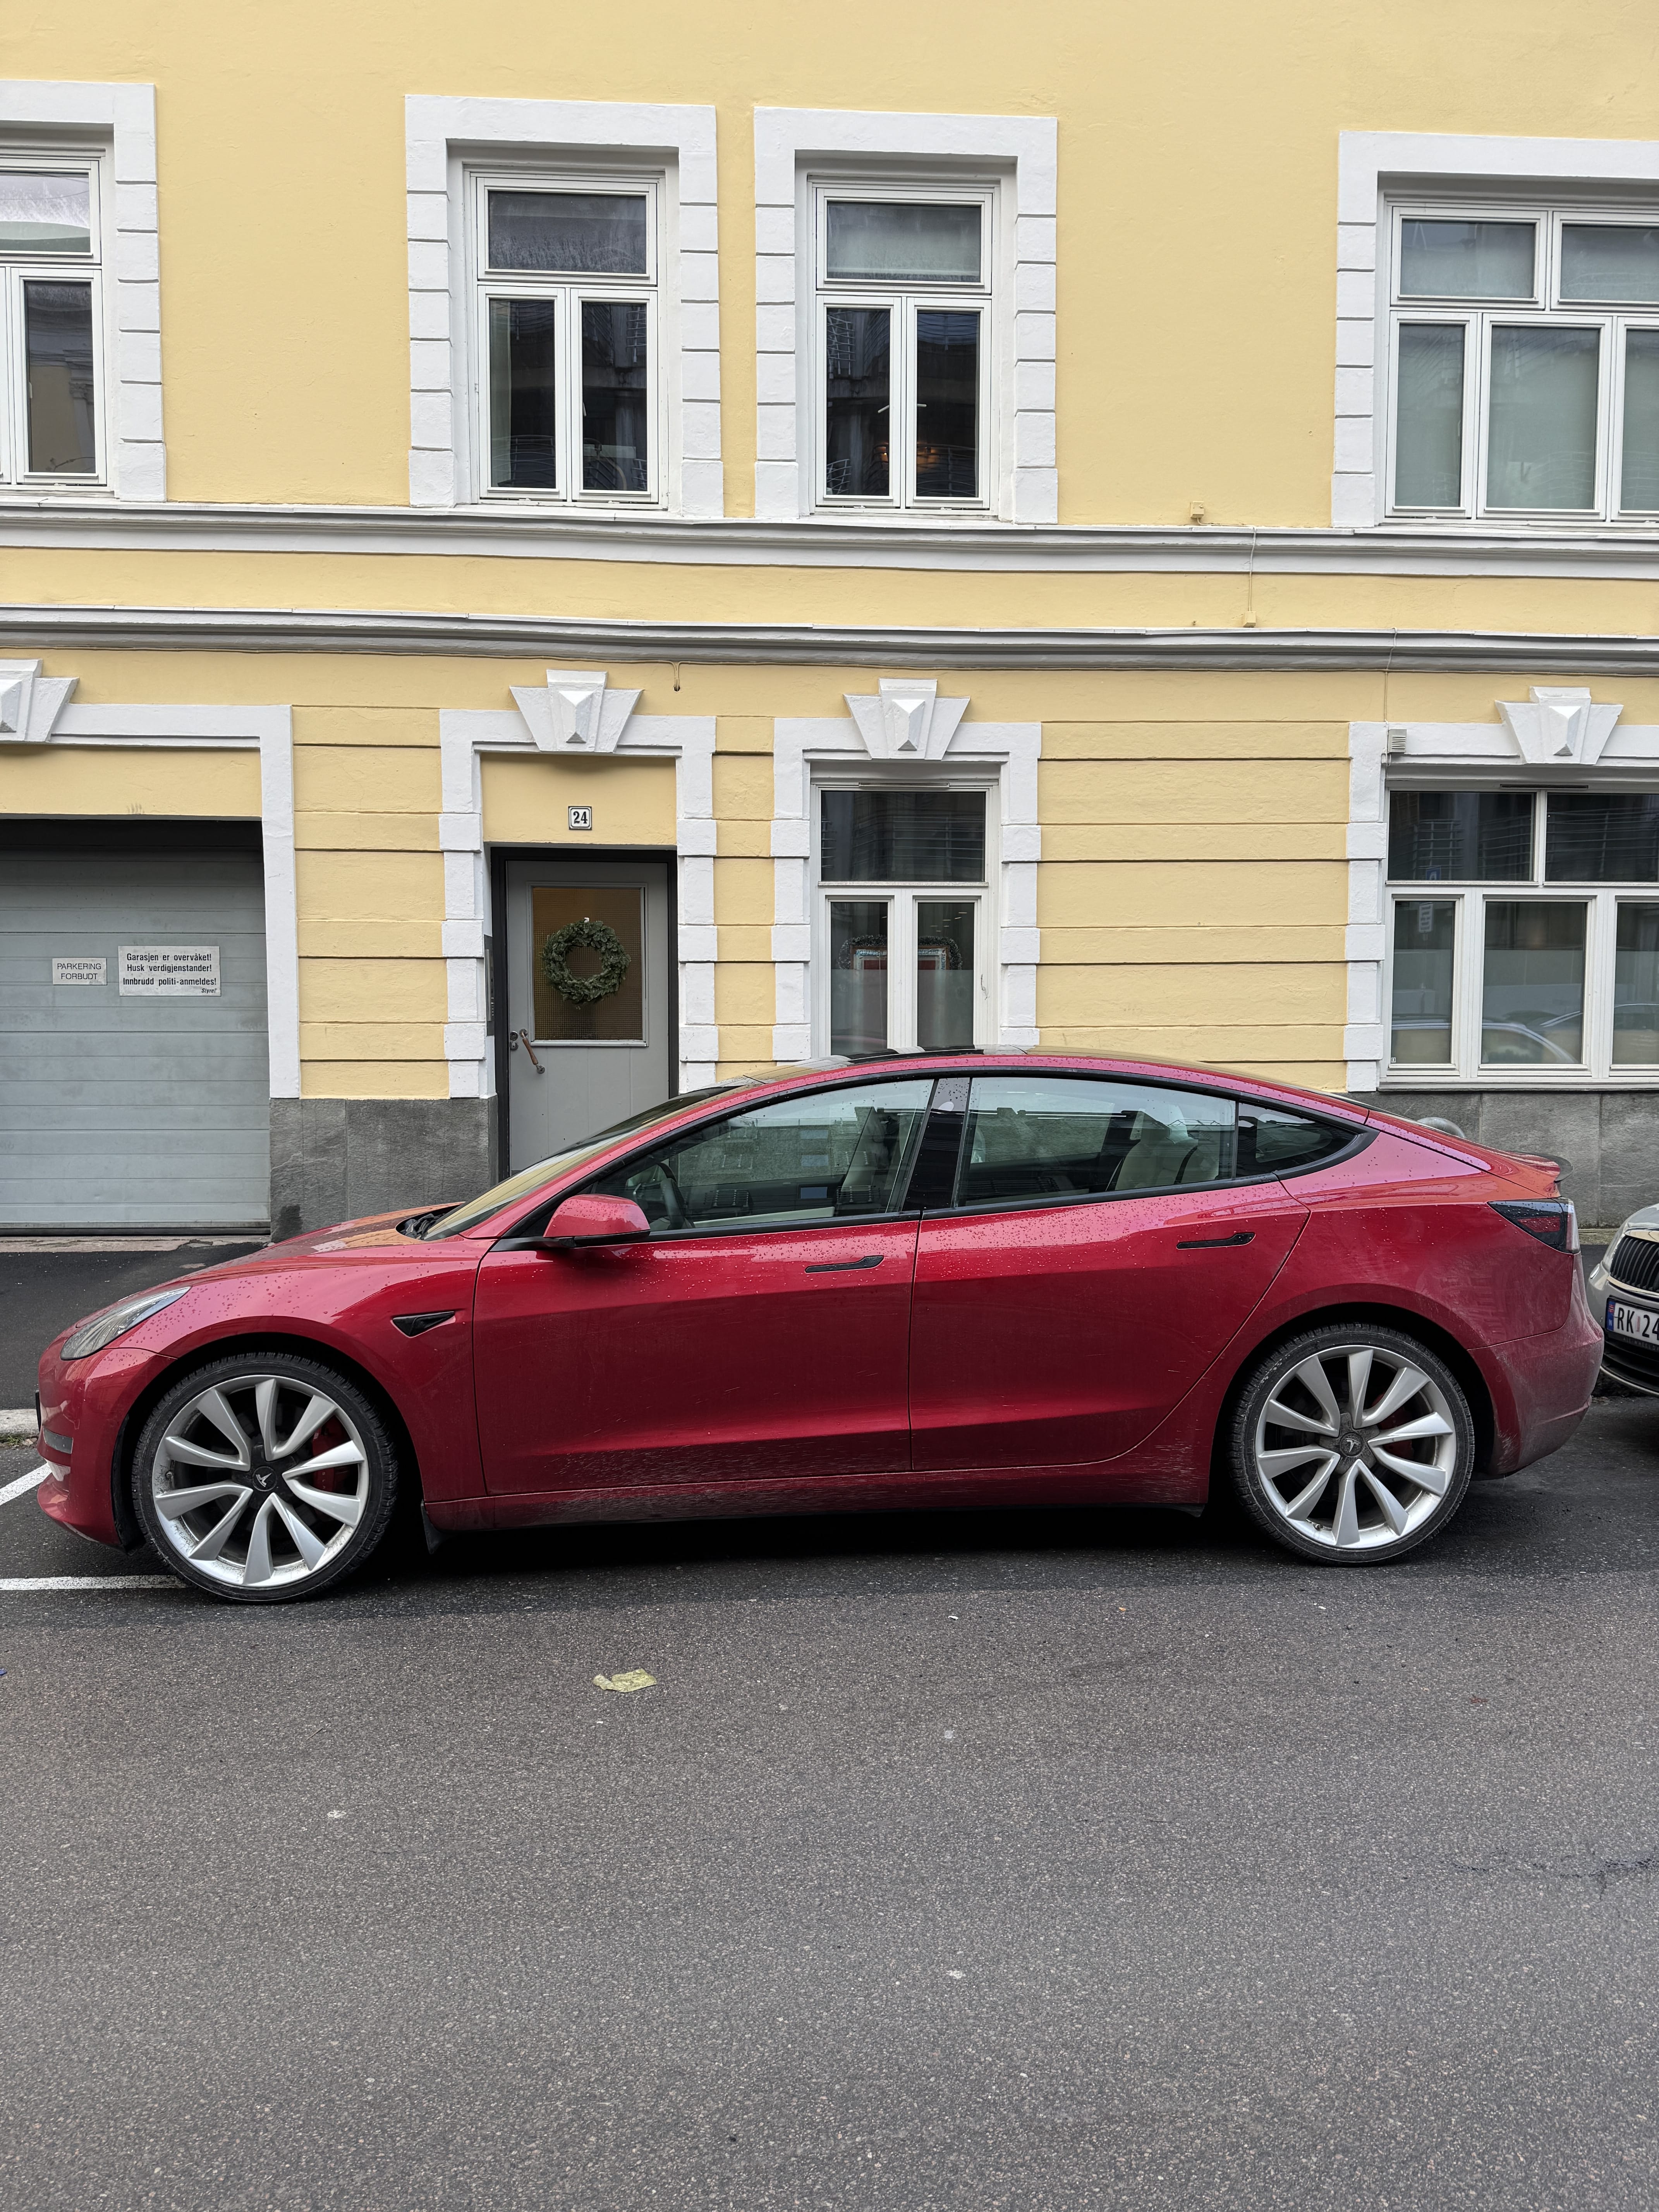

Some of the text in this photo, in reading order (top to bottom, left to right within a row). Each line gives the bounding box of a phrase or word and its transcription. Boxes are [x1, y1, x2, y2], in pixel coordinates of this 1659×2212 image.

[573, 811, 588, 824] 24
[127, 953, 158, 962] Garasjen
[149, 964, 211, 973] verdigjenstander!
[158, 977, 216, 986] politi-anmeldes!
[1617, 1307, 1635, 1333] RK
